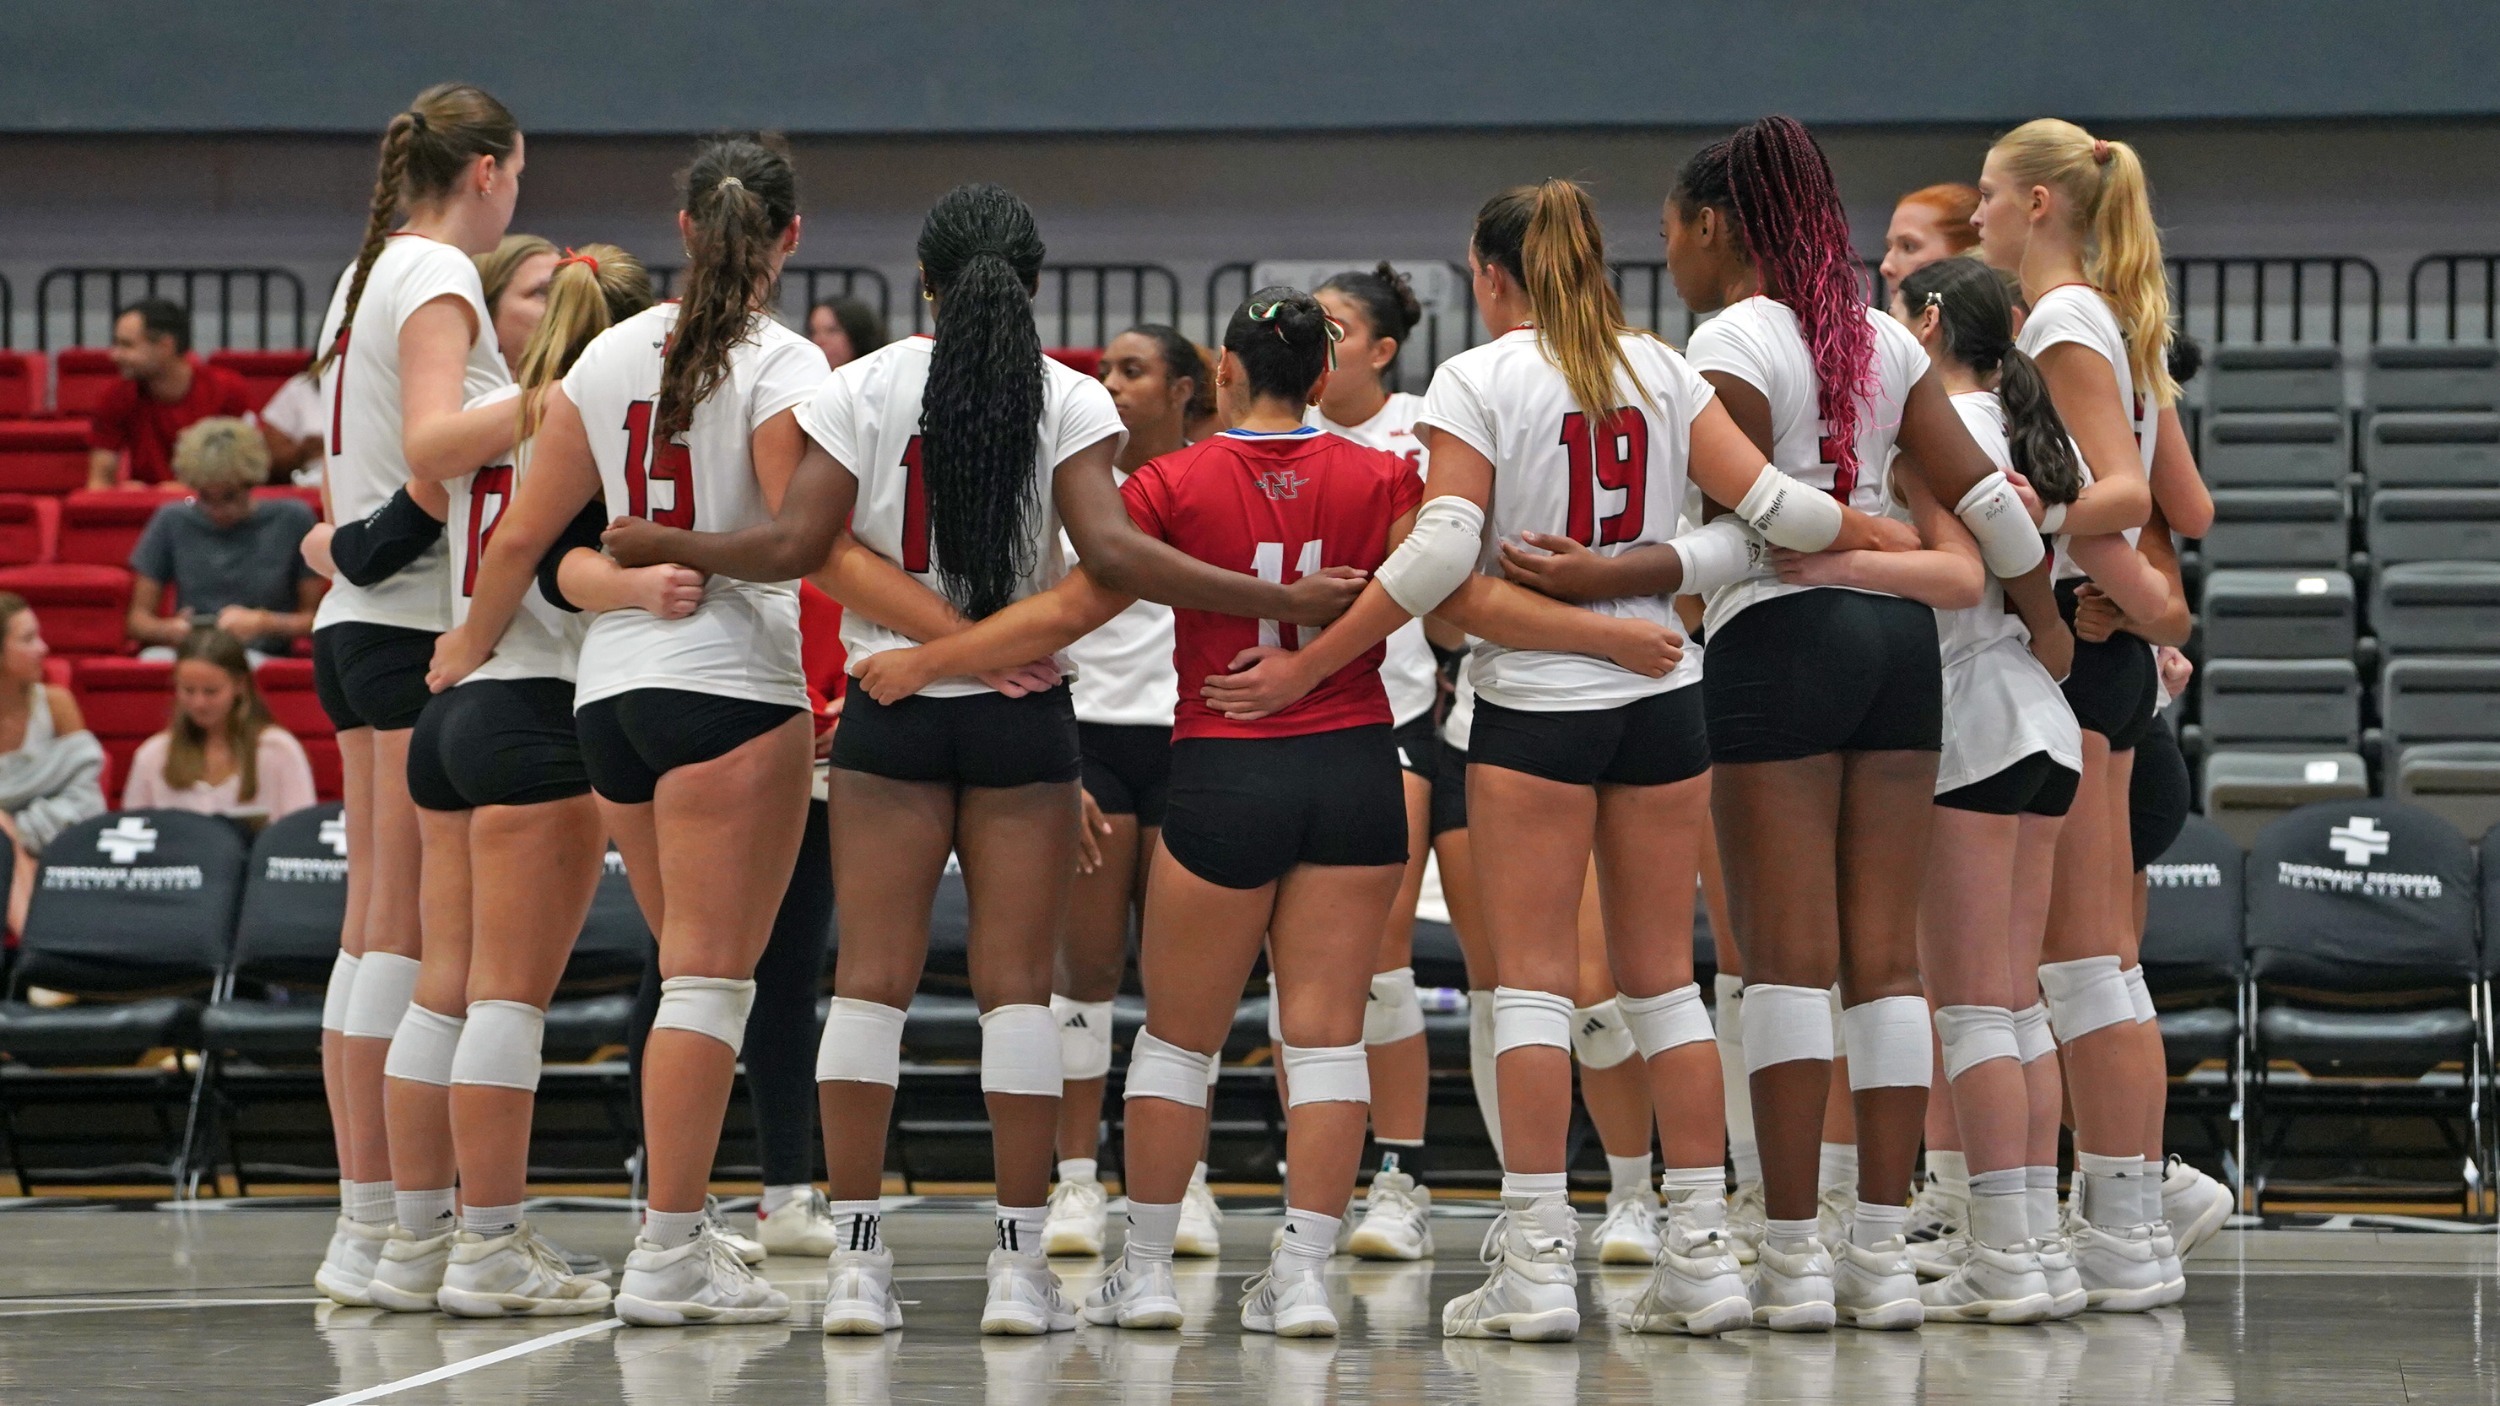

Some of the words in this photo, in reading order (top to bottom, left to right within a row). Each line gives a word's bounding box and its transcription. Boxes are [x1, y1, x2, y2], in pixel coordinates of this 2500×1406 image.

[622, 400, 695, 531] 15
[900, 435, 929, 573] 1
[1262, 470, 1297, 500] N
[1559, 406, 1648, 547] 19
[1250, 539, 1322, 650] 11
[2278, 873, 2353, 892] HEALTH
[2363, 881, 2442, 898] SYSTEM
[2367, 872, 2439, 888] REGIONAL
